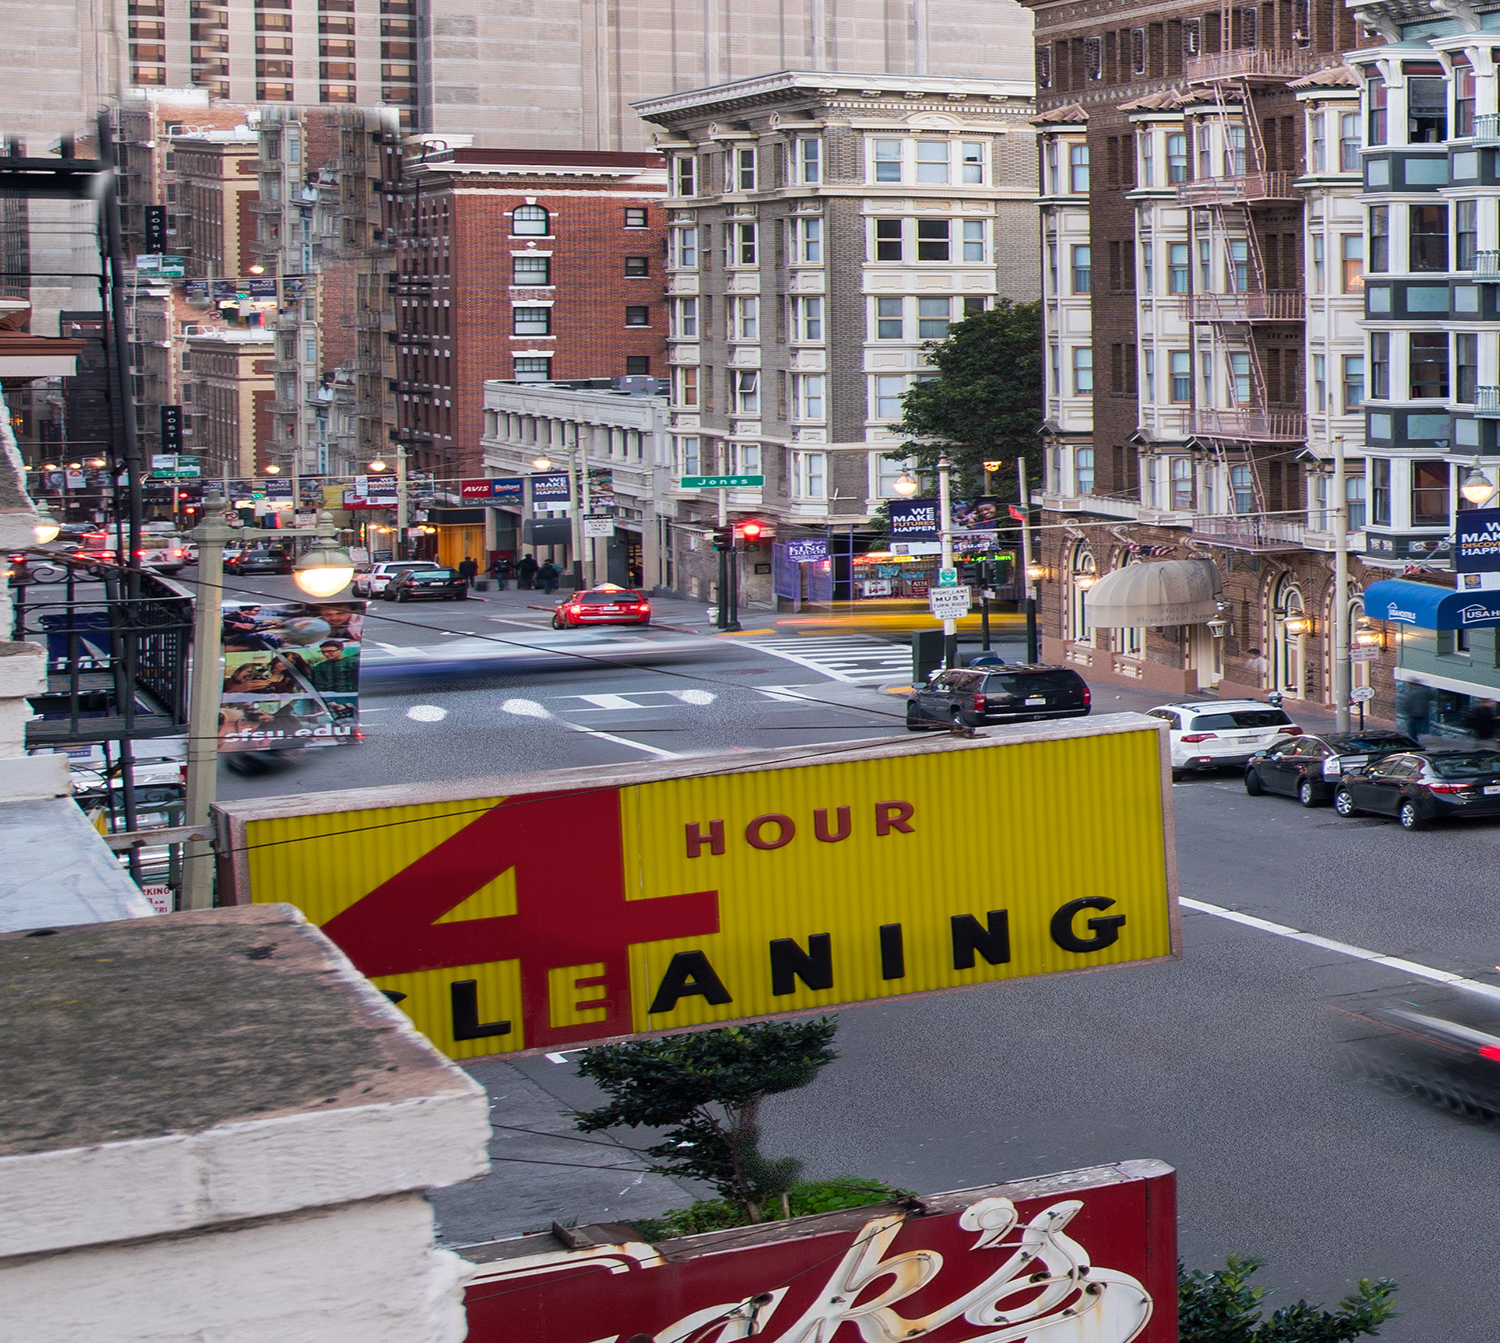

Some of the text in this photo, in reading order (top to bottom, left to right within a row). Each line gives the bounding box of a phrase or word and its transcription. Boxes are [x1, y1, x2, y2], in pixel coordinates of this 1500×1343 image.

[698, 478, 749, 486] Jones
[911, 507, 935, 515] WE
[893, 514, 935, 523] MAKE
[893, 520, 935, 528] FUTURES
[893, 525, 936, 533] HAPPEN
[789, 545, 827, 553] KING
[1467, 610, 1491, 618] USA
[224, 723, 350, 743] sfsu.edu
[324, 788, 915, 1046] 4 HOUR
[384, 895, 1126, 1042] LEANING
